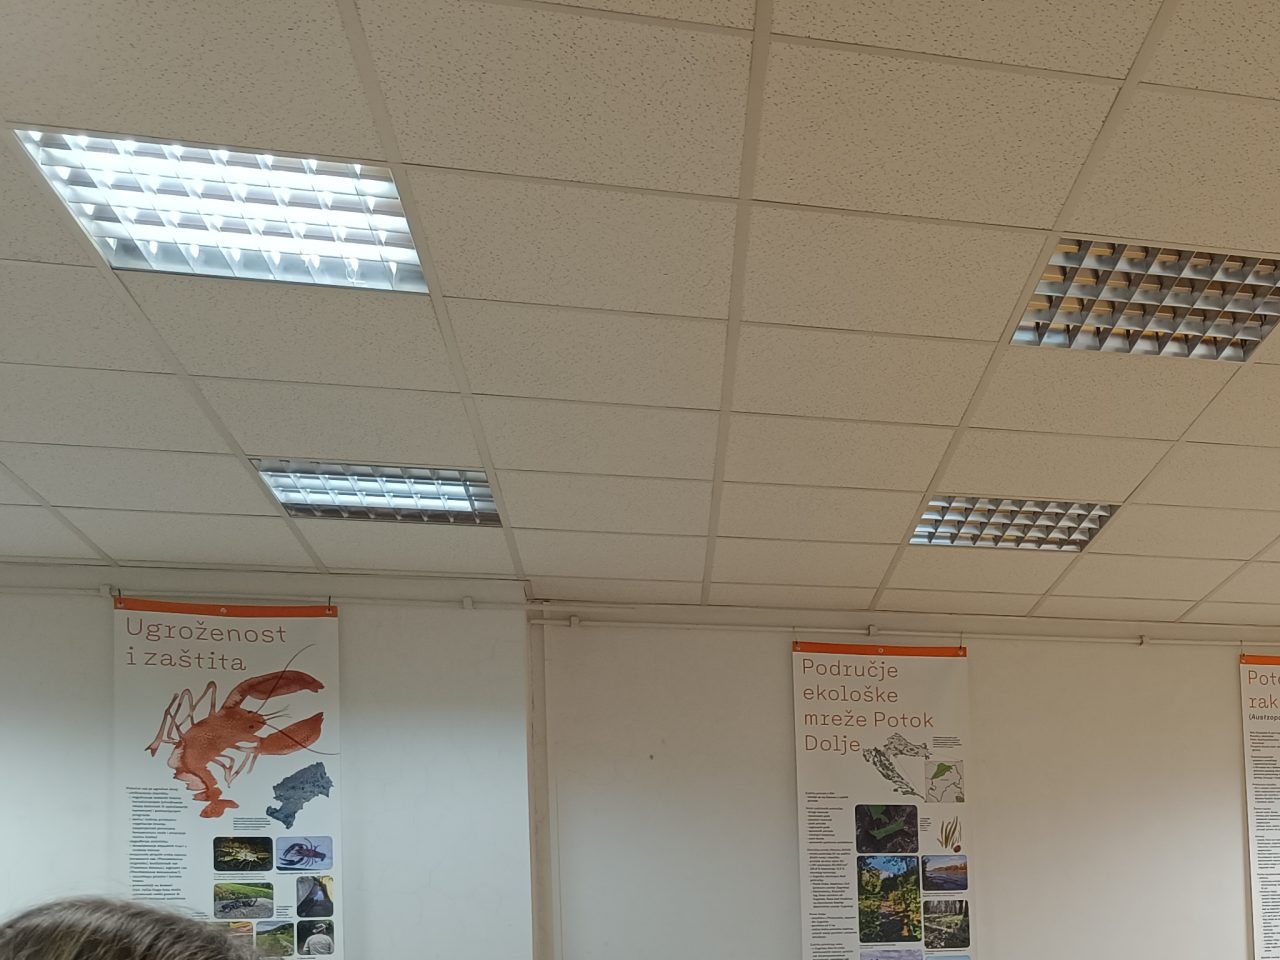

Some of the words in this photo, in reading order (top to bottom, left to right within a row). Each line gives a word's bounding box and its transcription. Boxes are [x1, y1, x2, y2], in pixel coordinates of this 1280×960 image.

[126, 616, 287, 643] Ugroženost
[126, 646, 137, 666] i
[144, 649, 247, 671] zaštita
[802, 658, 898, 682] Područje
[803, 684, 898, 703] ekološke
[1249, 693, 1279, 709] rak
[804, 709, 867, 728] mreže
[874, 711, 934, 728] Potok
[805, 734, 860, 756] Dolje
